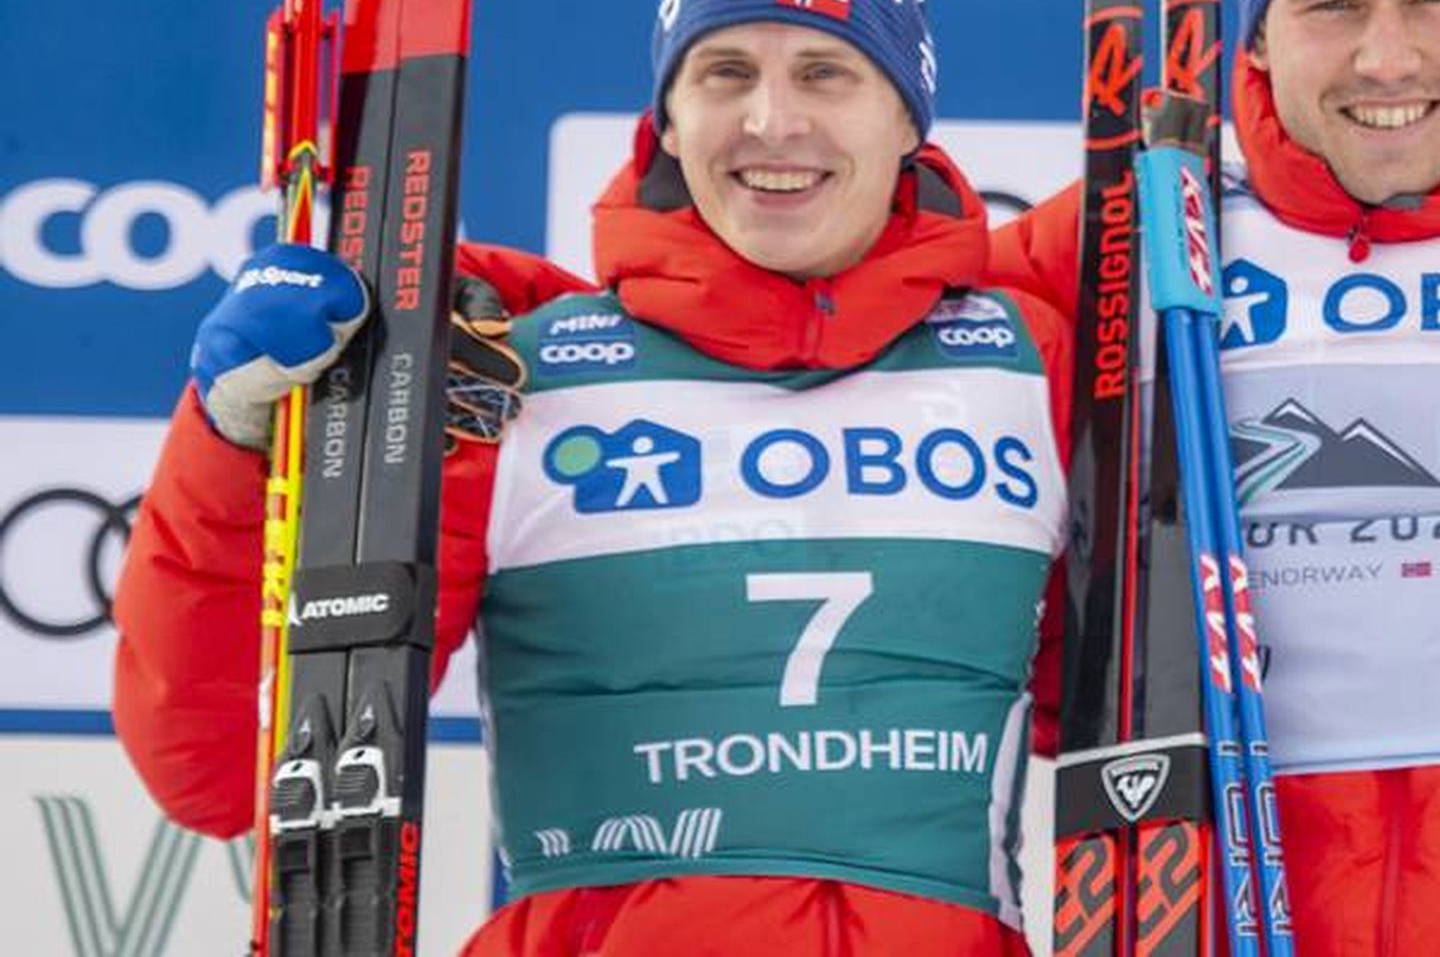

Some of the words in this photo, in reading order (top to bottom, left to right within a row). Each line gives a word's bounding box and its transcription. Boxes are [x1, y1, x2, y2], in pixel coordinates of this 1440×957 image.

[394, 150, 431, 311] REDSTER
[548, 313, 622, 336] MINI
[938, 326, 1015, 349] coop
[539, 342, 636, 365] coop
[384, 351, 413, 465] CARBON
[738, 426, 1038, 509] OBOS
[301, 593, 390, 620] ATOMIC
[745, 570, 874, 707] 7
[633, 730, 988, 784] TRONDHEIM
